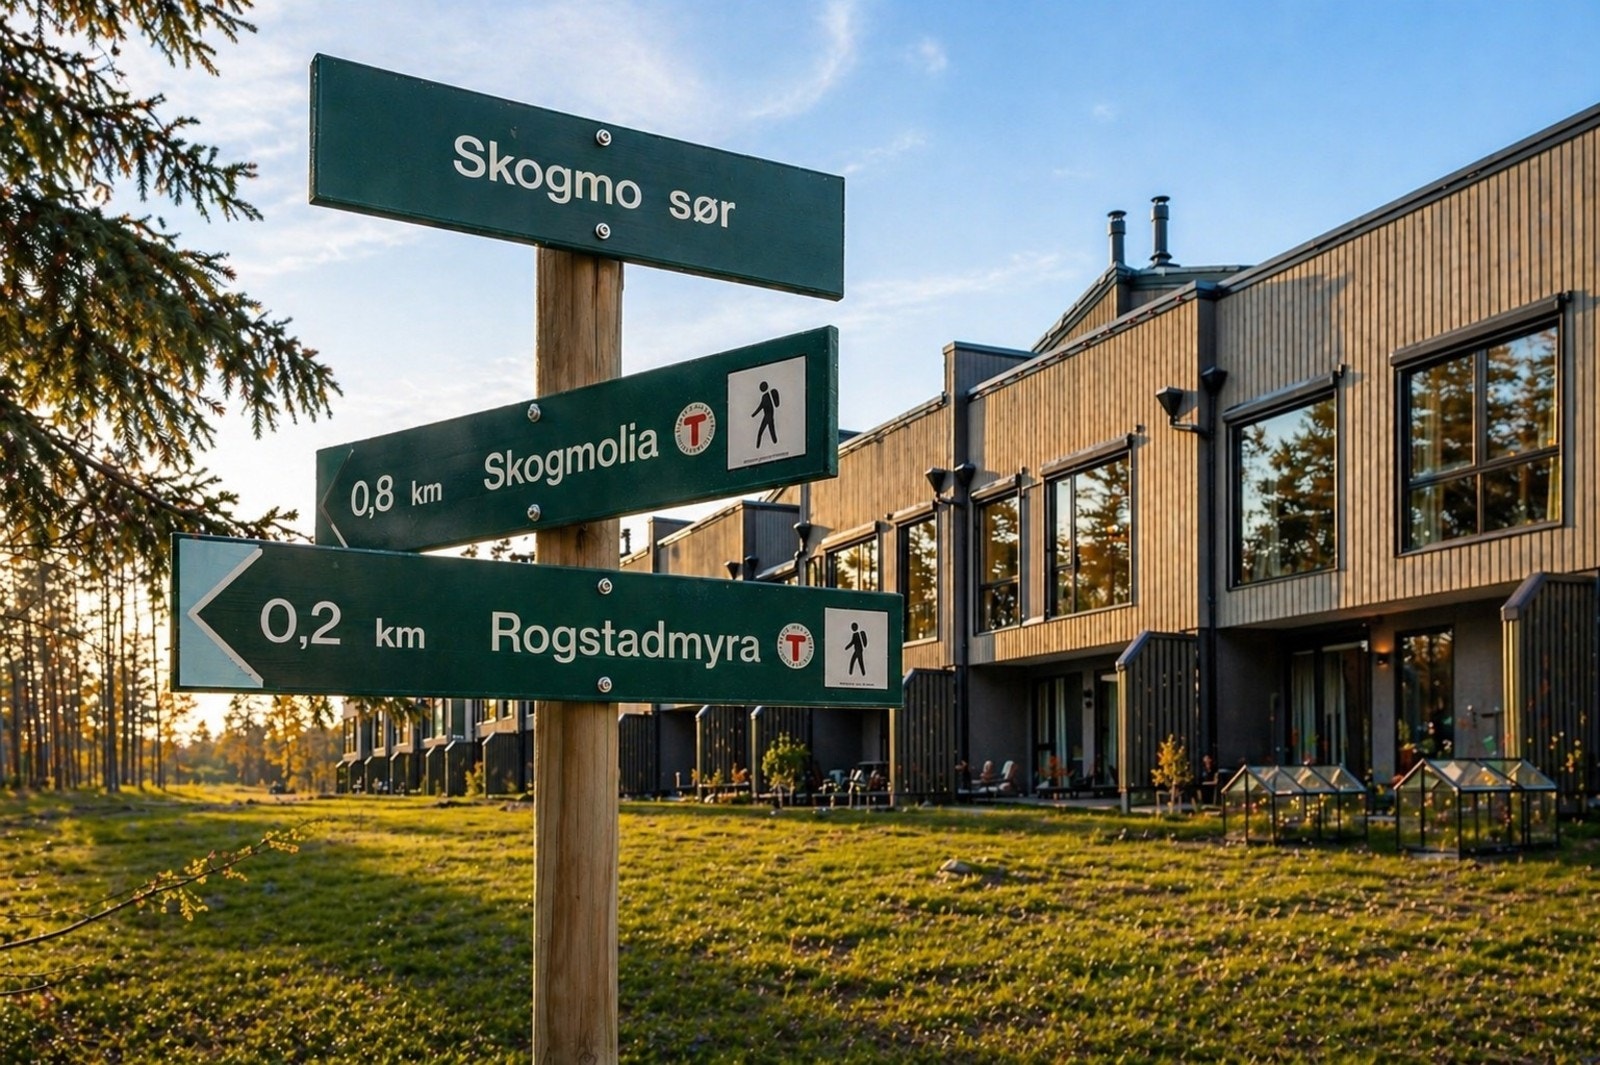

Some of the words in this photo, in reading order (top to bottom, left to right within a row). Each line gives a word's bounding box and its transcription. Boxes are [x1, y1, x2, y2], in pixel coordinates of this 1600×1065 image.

[452, 134, 642, 210] Skogmo
[668, 190, 736, 228] sør
[350, 474, 394, 519] 0,8
[410, 480, 443, 506] km
[483, 424, 659, 491] Skogmolia
[260, 598, 341, 650] 0,2
[375, 617, 425, 649] km
[491, 611, 761, 669] Rogstadmyra
